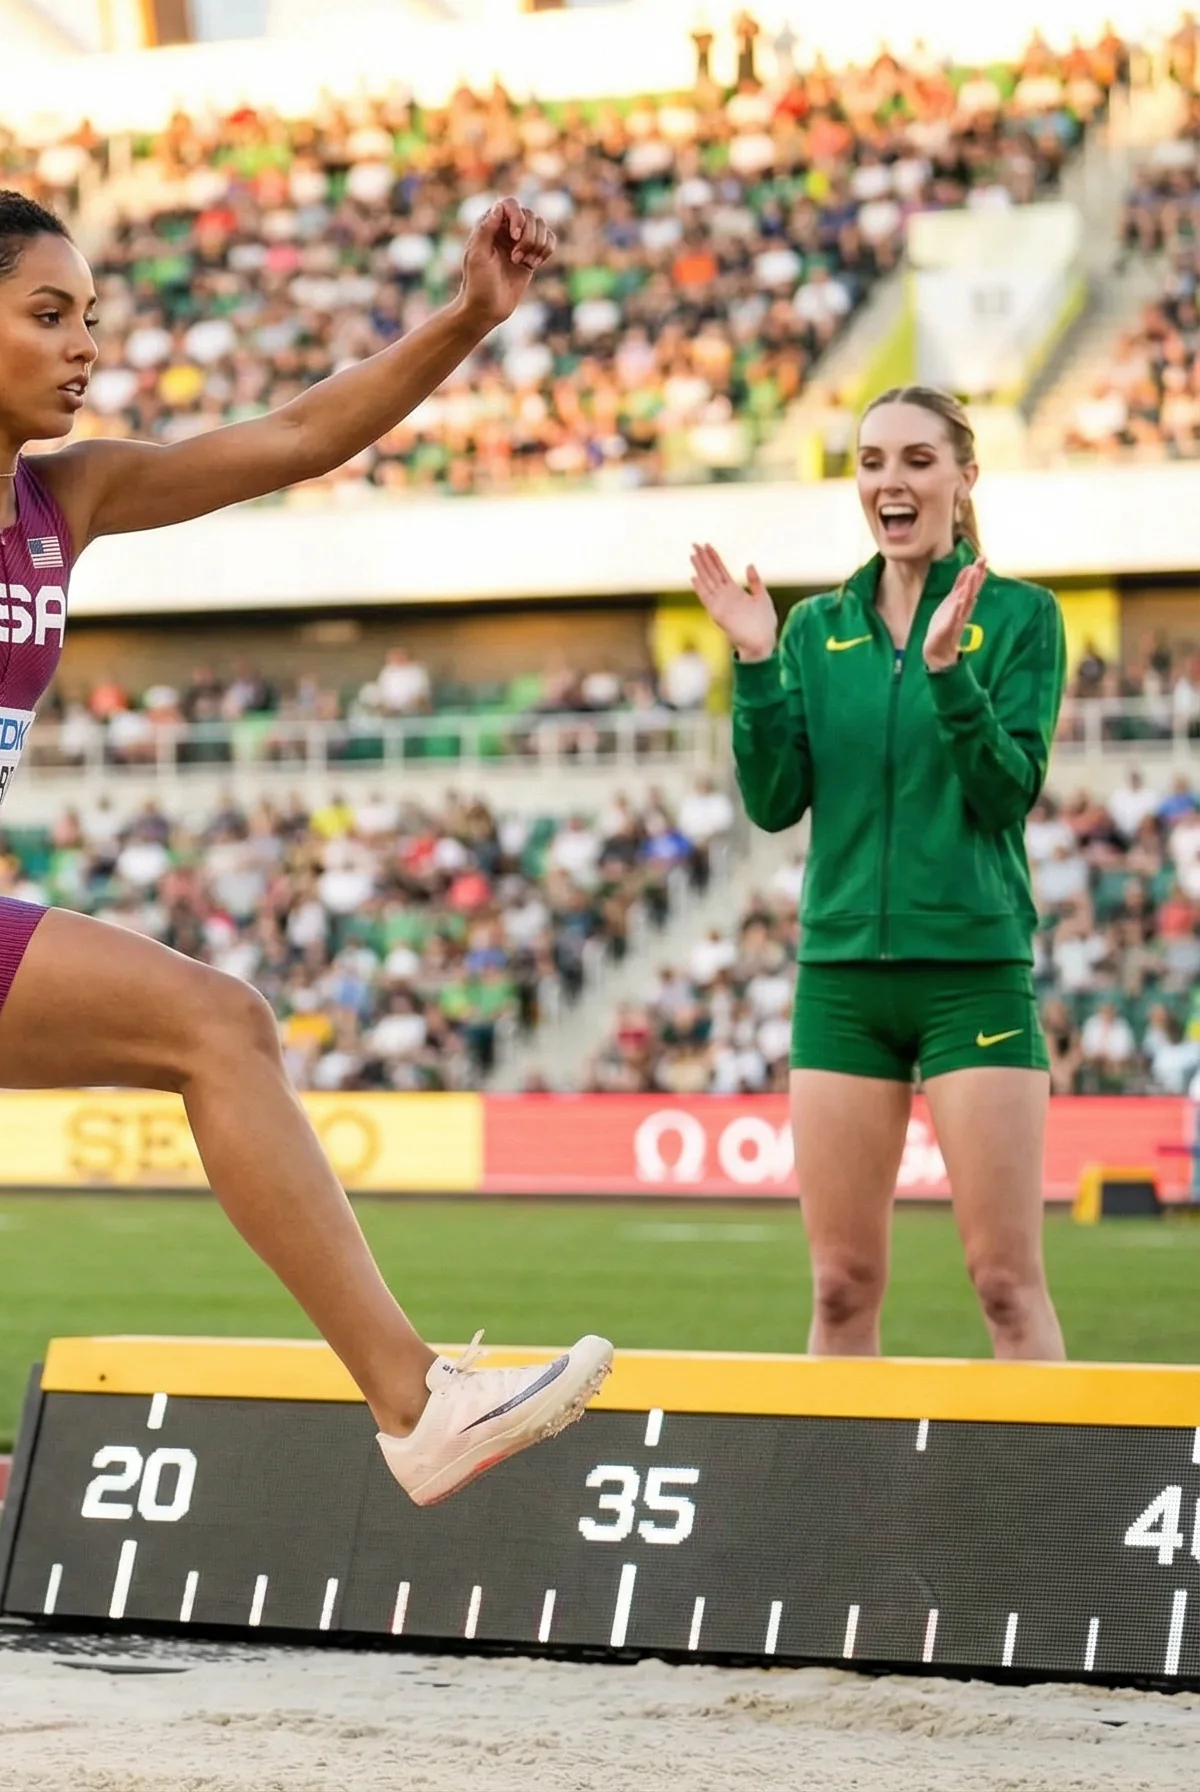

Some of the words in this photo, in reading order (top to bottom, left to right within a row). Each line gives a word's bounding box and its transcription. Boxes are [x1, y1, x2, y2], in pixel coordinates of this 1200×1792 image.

[68, 1106, 382, 1178] SEO
[81, 1445, 198, 1521] 20
[578, 1464, 700, 1544] 35
[1124, 1484, 1200, 1565] 4
